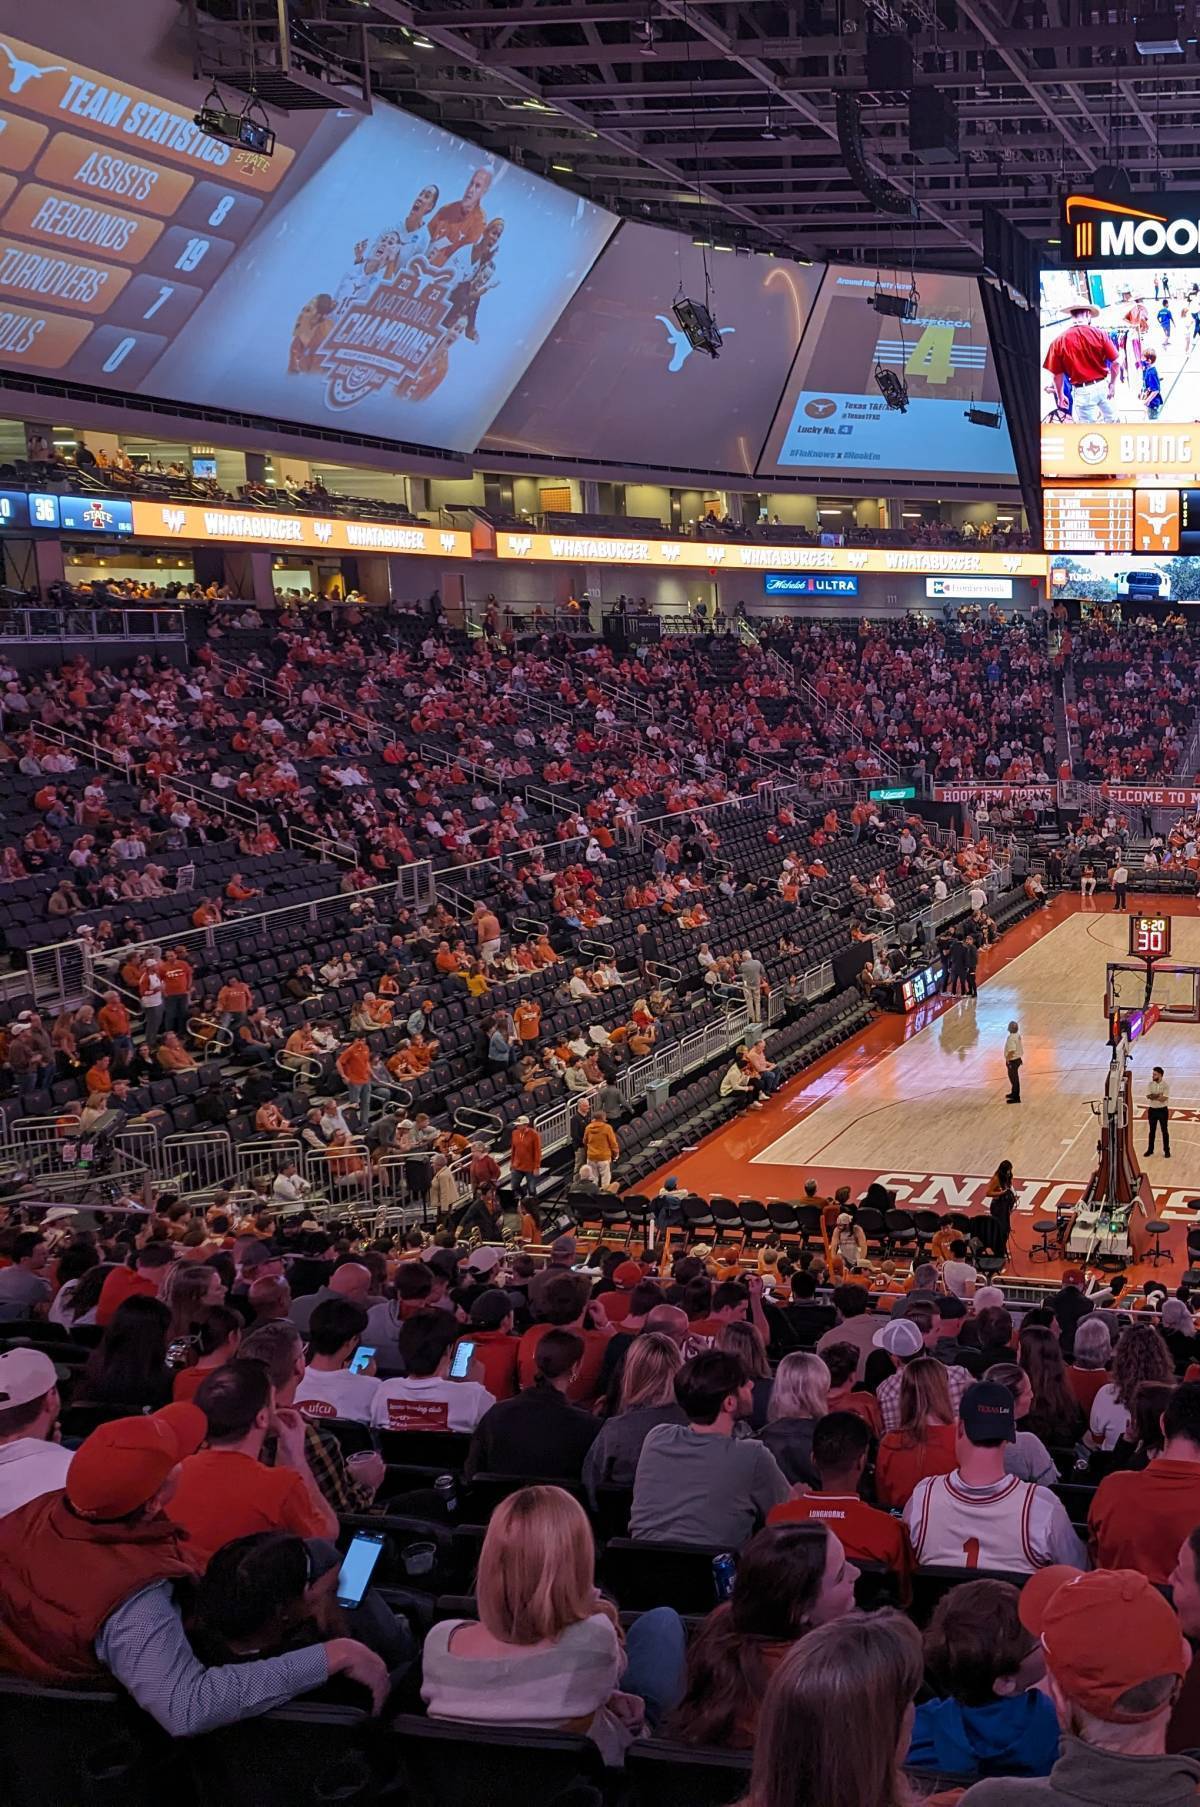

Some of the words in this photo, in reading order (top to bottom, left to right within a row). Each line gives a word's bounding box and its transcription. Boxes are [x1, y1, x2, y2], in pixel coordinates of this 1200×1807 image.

[59, 76, 131, 127] TEAM
[235, 151, 272, 173] STATE
[74, 151, 160, 201] ASSISTS
[208, 195, 235, 226] 8
[31, 196, 138, 250] REBOUNDS
[174, 237, 210, 272] 19
[0, 247, 109, 303] TURNOVERS
[372, 292, 438, 327] NATIONAL
[0, 312, 46, 354] OULS
[333, 313, 437, 363] CHAMPIONS
[102, 337, 137, 373] 0
[905, 327, 955, 385] 4
[845, 401, 867, 410] Texas
[797, 425, 823, 435] Lucky
[823, 426, 837, 435] No.
[1120, 434, 1192, 464] BRING
[35, 498, 54, 521] 36
[83, 510, 113, 524] STATE
[203, 512, 304, 542] WHATABURGER
[346, 525, 426, 551] WHATABURGER
[550, 538, 652, 560] WHATABURGER
[740, 547, 837, 568] WHATABURGER
[885, 552, 983, 571] WHATABURGER
[767, 579, 806, 590] Michelob
[816, 579, 855, 590] ULTRA
[943, 790, 978, 802] HOOK
[1011, 788, 1051, 800] HORNS
[1108, 789, 1164, 803] ELCOME
[1168, 791, 1185, 804] TO
[1140, 919, 1165, 932] 6:20
[1138, 932, 1162, 950] 30
[308, 1403, 332, 1415] ufcu
[977, 1405, 999, 1414] TEXAS
[808, 1509, 845, 1519] LONGHORNS
[962, 1537, 980, 1568] 1
